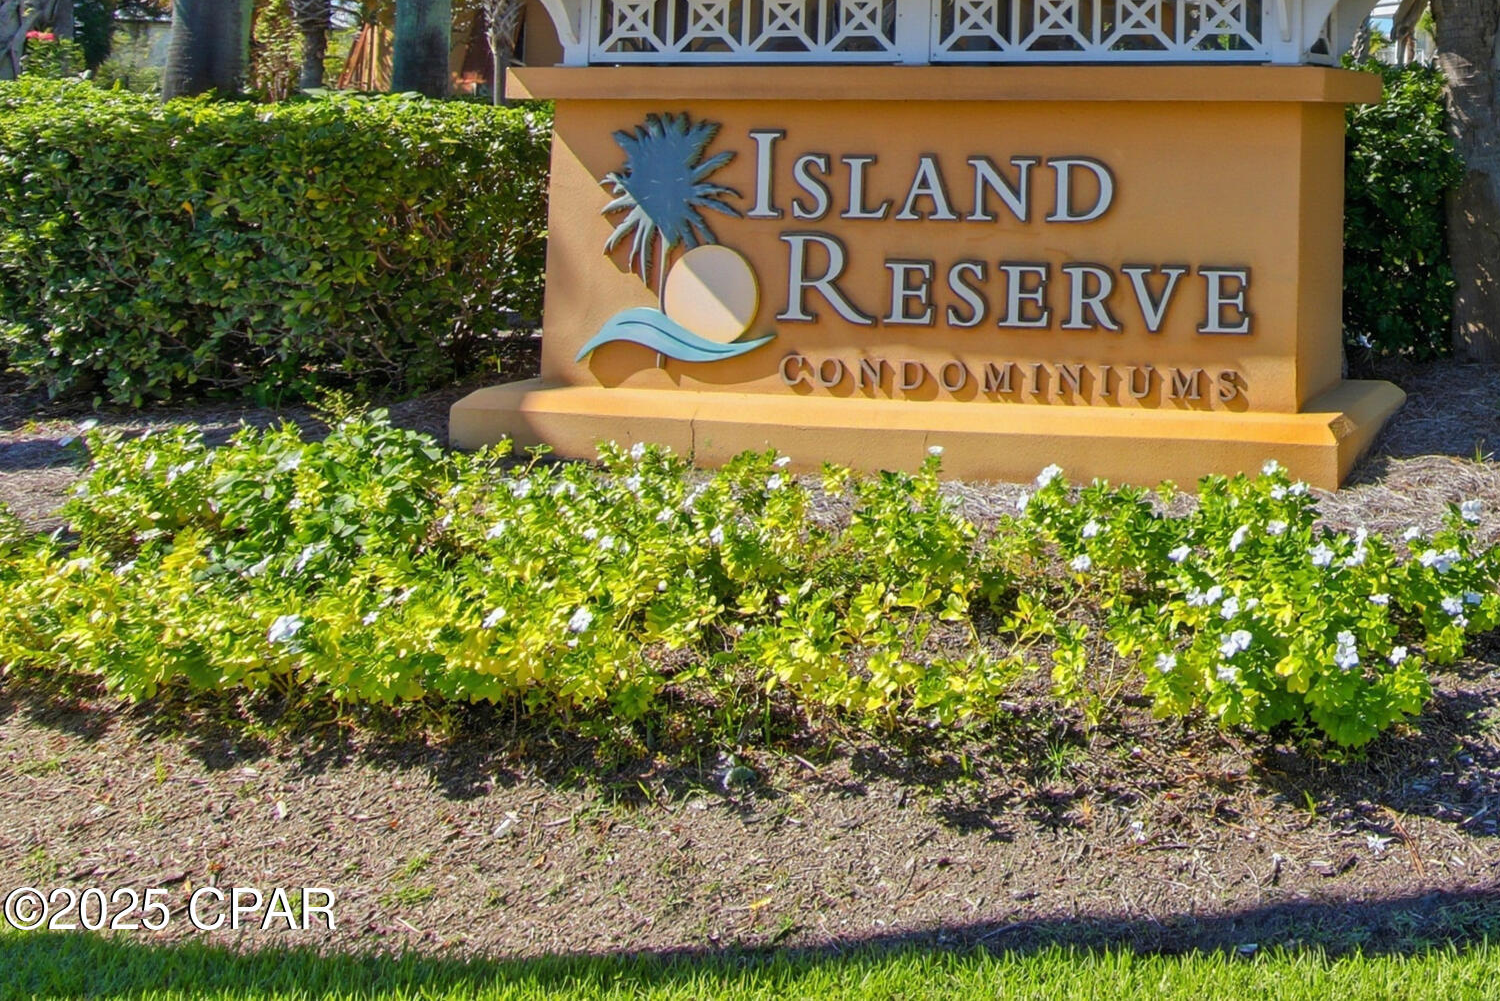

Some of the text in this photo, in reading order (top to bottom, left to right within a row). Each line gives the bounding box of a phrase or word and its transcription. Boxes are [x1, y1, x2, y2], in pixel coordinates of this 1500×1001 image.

[746, 128, 1119, 224] ISLAND
[776, 231, 1253, 336] RESERVE
[779, 353, 1244, 400] CONDOMINIUMS
